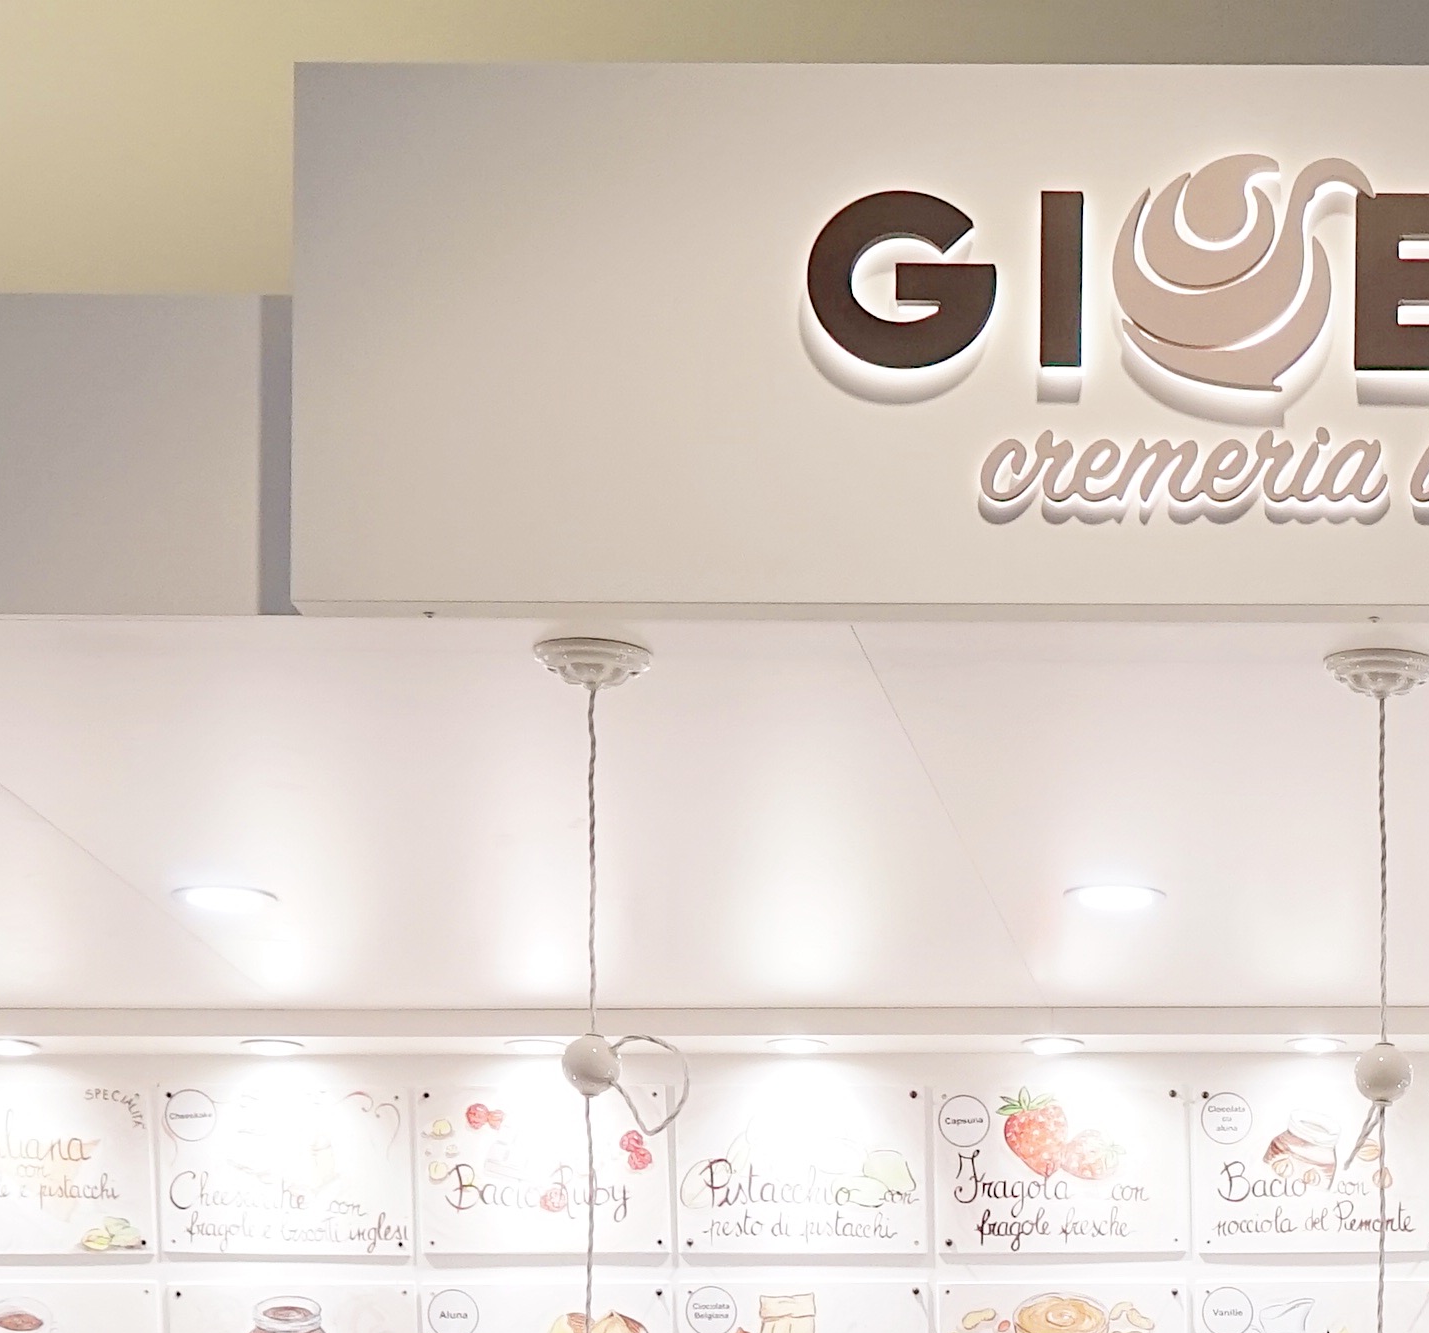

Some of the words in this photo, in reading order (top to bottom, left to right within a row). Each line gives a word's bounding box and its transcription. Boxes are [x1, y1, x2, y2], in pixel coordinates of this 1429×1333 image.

[978, 424, 1388, 506] cremeria
[31, 1173, 120, 1208] pistacchi
[445, 1164, 535, 1211] Bacio
[954, 1150, 1072, 1214] Fragola
[1218, 1161, 1307, 1202] Bacio
[348, 1211, 409, 1253] inglesi
[772, 1210, 791, 1237] di
[975, 1208, 1051, 1251] fragole
[1061, 1207, 1133, 1243] fresche
[1213, 1207, 1300, 1236] nocciola
[1305, 1209, 1329, 1232] del
[1335, 1200, 1417, 1234] Piemonte
[439, 1310, 469, 1319] Aluna
